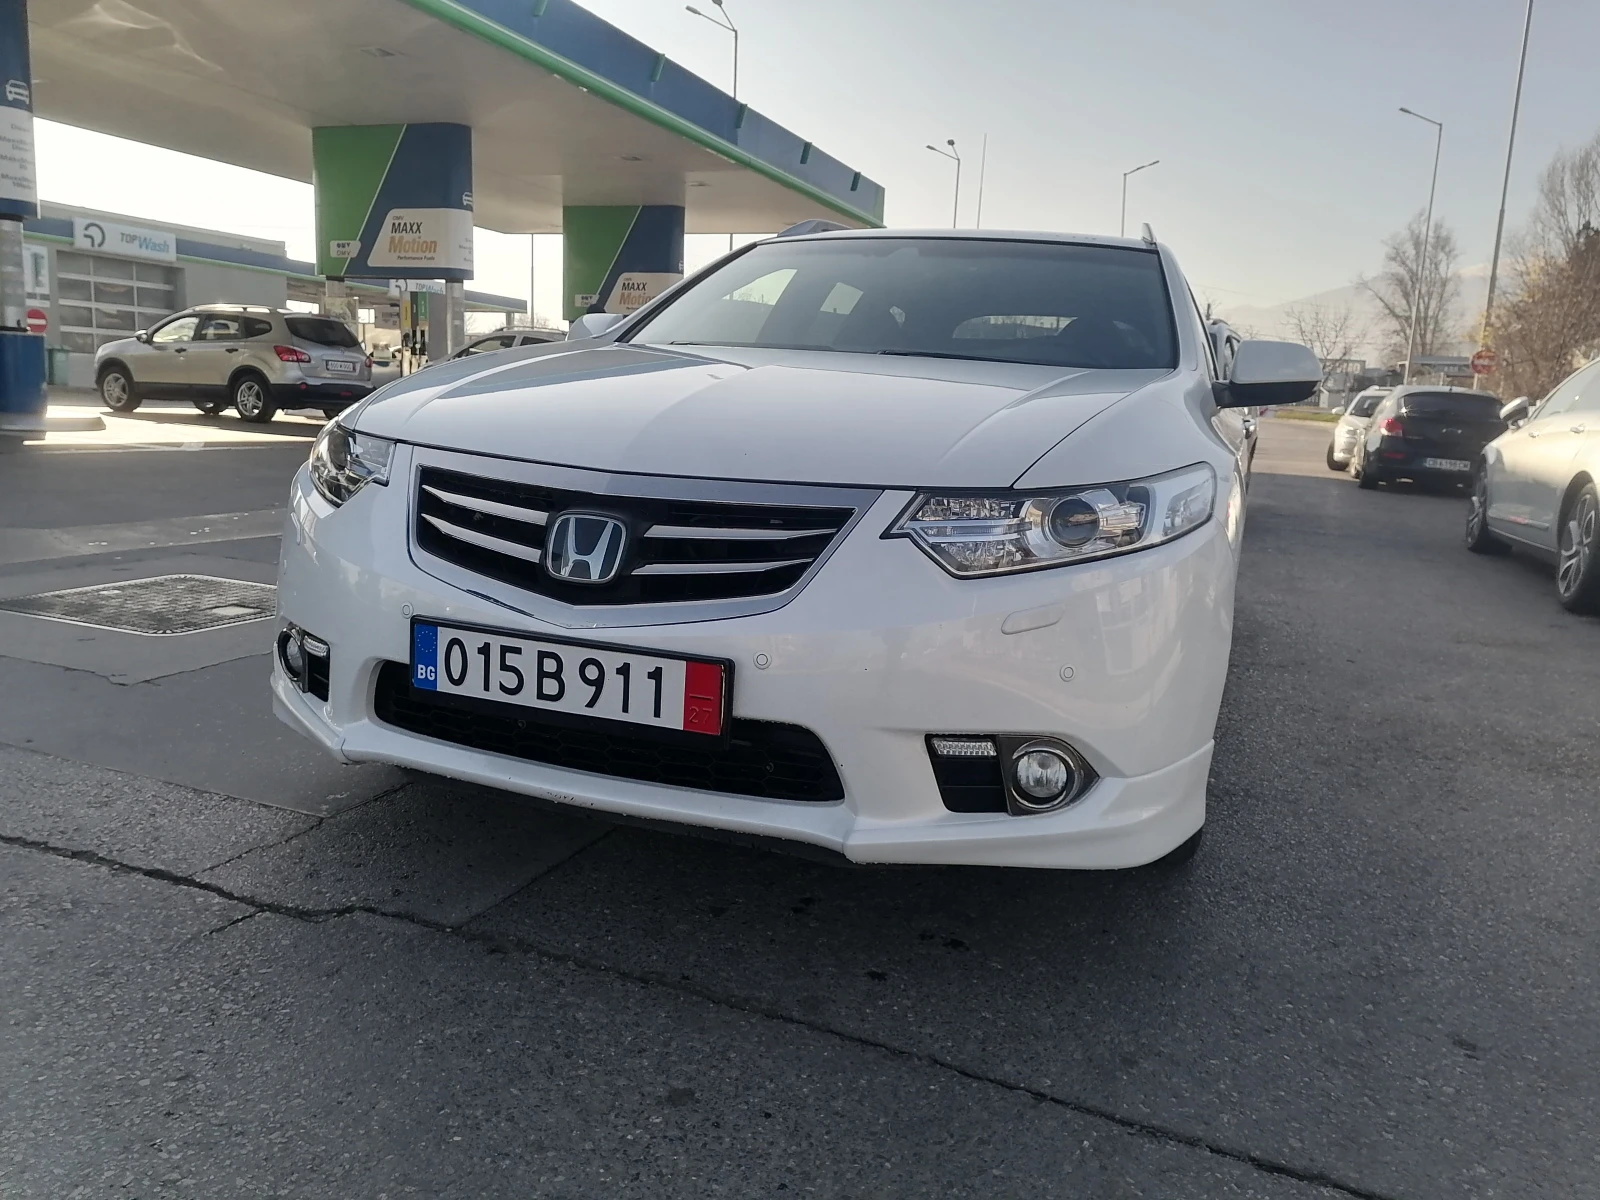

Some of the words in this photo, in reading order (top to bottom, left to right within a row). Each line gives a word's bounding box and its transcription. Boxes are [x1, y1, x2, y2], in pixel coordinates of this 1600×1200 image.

[391, 222, 422, 234] MAXX
[388, 236, 437, 253] Motion
[621, 282, 647, 291] MAXX
[417, 664, 436, 681] BG
